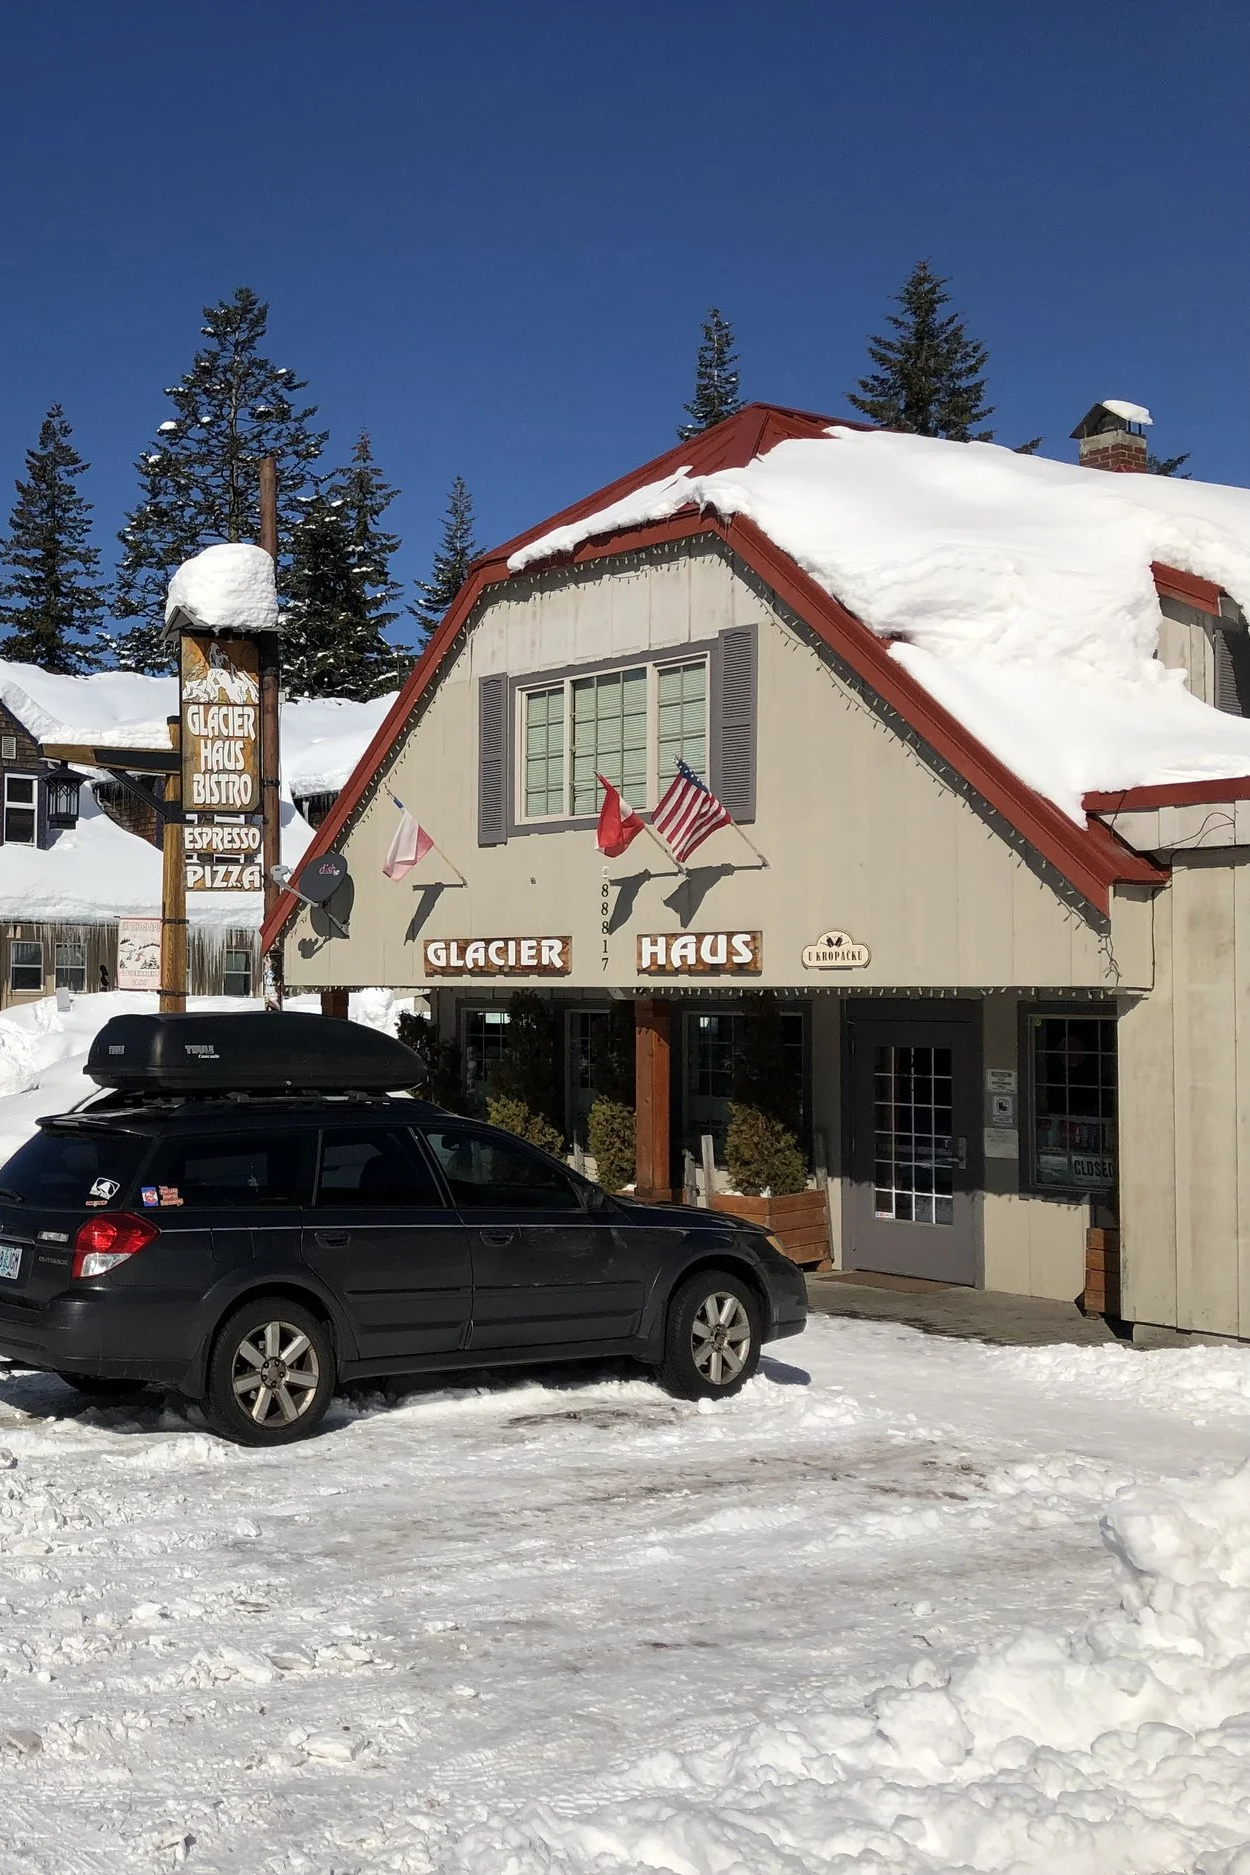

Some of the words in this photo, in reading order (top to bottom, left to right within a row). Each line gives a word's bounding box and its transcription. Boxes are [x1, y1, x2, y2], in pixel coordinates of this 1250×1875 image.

[186, 704, 256, 741] GLACIER
[200, 738, 245, 773] HAUS
[192, 773, 252, 809] BISTRO
[184, 826, 261, 852] ESPRESSO
[186, 865, 261, 889] PIZZA
[425, 938, 565, 970] GLACIER
[640, 933, 754, 970] HAUS
[808, 951, 813, 961] U
[1073, 1159, 1114, 1178] CLOSED
